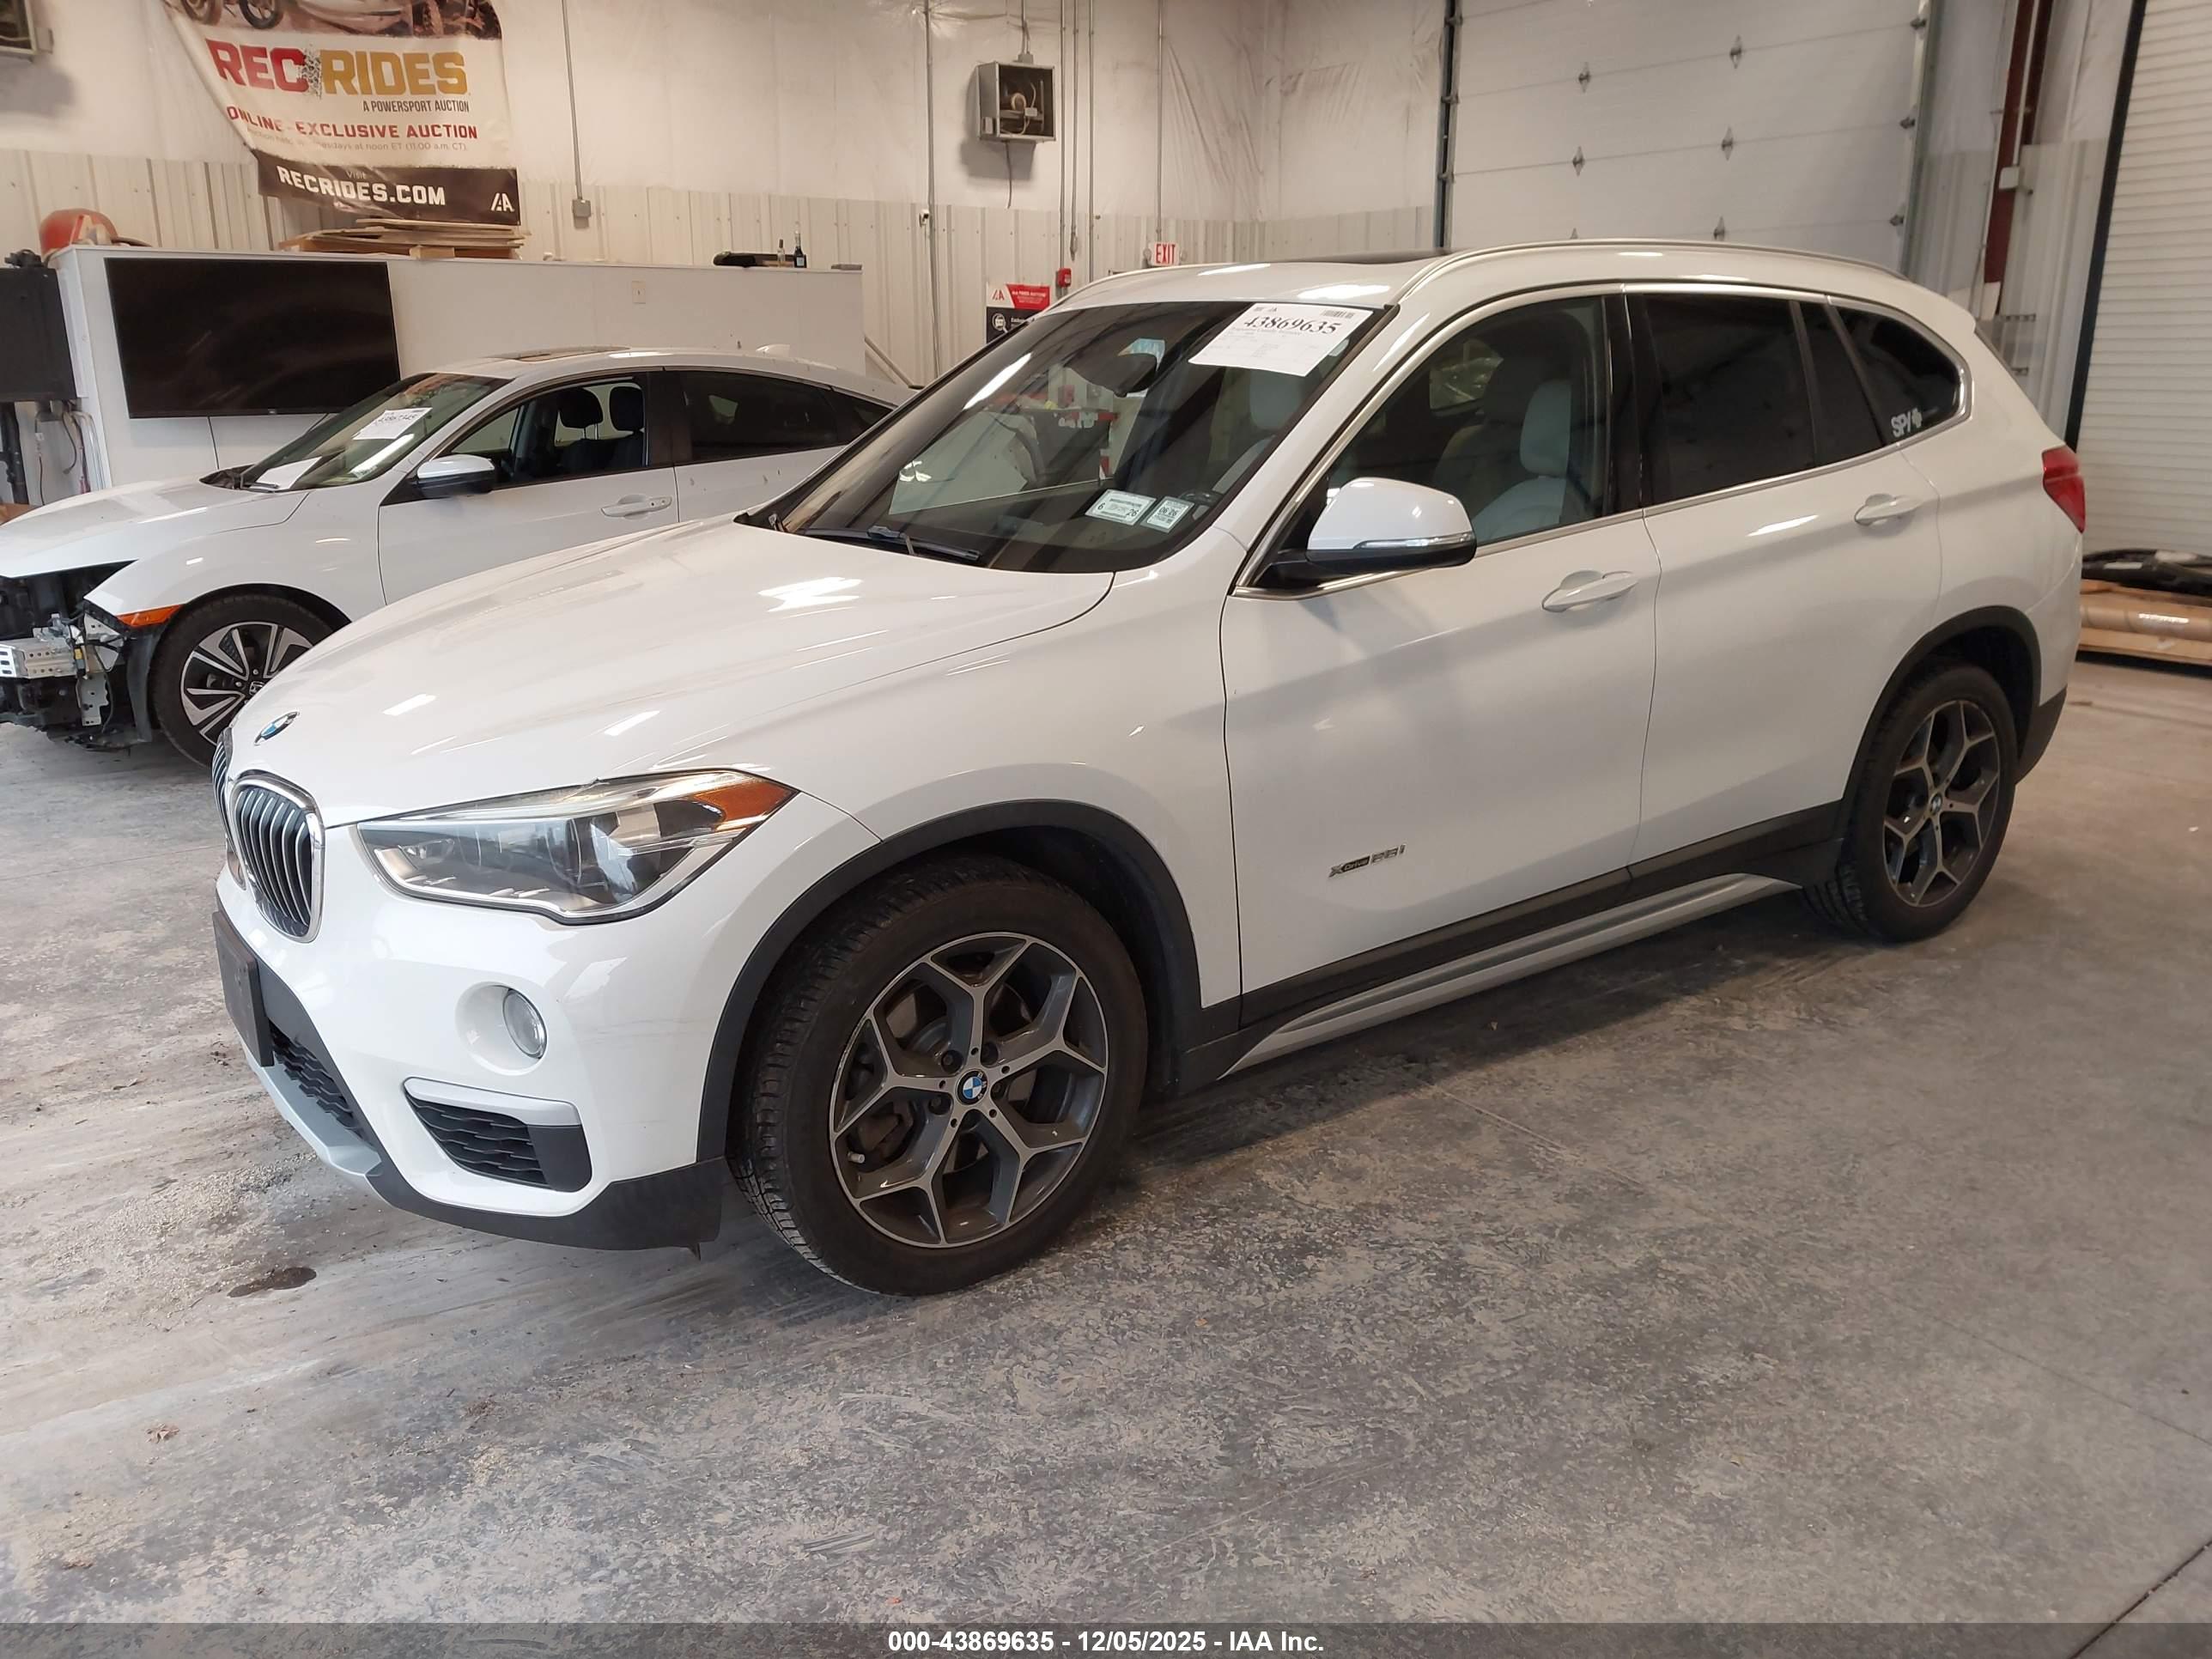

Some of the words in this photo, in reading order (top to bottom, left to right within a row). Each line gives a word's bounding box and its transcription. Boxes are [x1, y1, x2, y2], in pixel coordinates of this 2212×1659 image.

[204, 38, 309, 93] REC
[319, 50, 468, 96] RIDES
[363, 100, 370, 112] A
[371, 100, 432, 112] POWERSPORT
[434, 100, 470, 112] AUCTION
[406, 124, 478, 139] AUCTION
[346, 171, 367, 180] Visit
[276, 166, 446, 206] RECRIDES.COM
[1156, 243, 1176, 264] EXIT
[1243, 315, 1343, 335] 43869635
[1097, 501, 1106, 510] 6
[1126, 508, 1139, 517] 26
